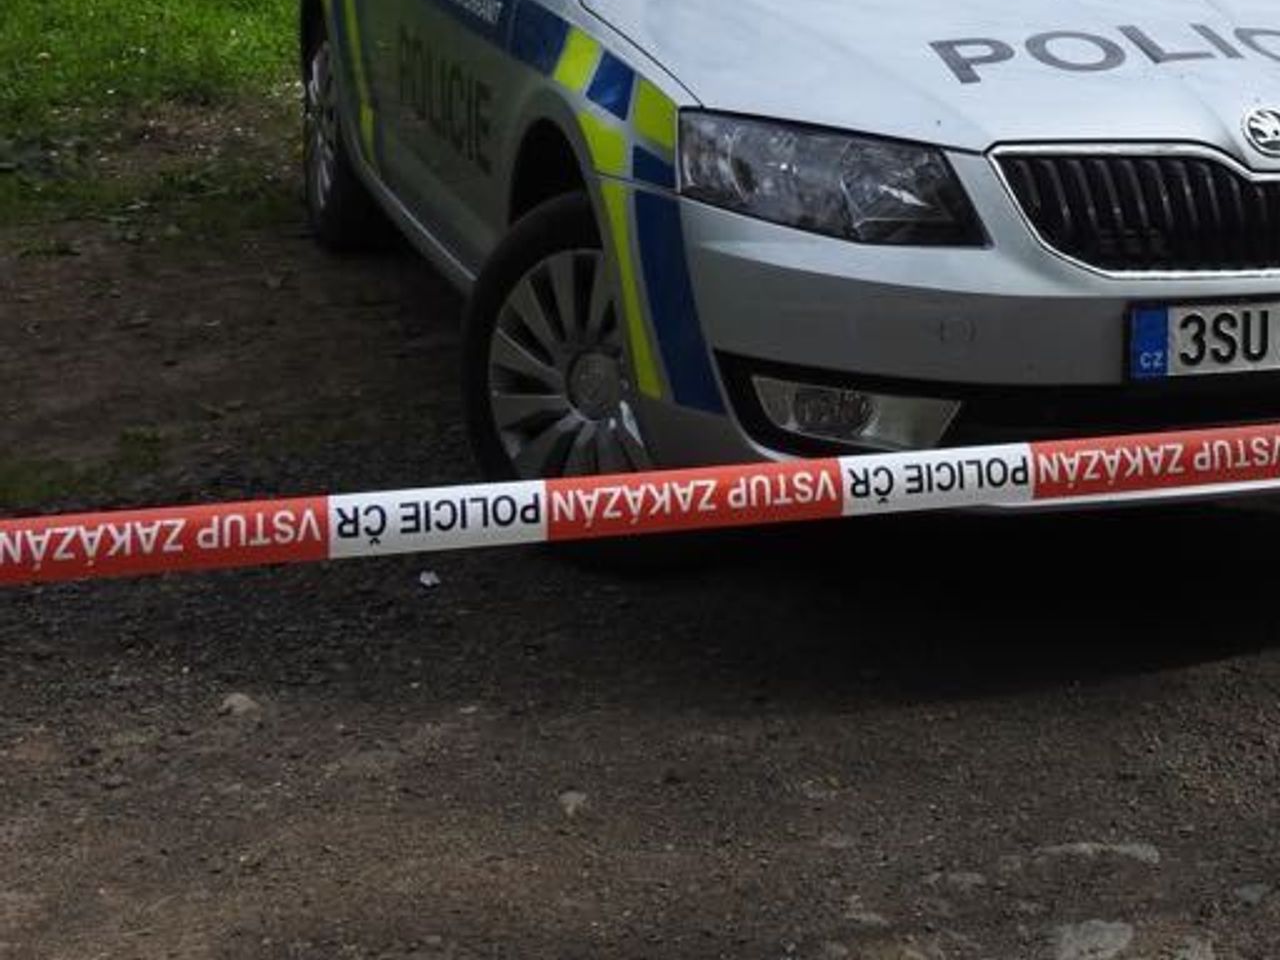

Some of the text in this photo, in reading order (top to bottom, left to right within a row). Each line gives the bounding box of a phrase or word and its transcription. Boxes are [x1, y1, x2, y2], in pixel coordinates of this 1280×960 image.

[399, 24, 492, 175] POLICIE
[1139, 351, 1164, 370] CZ
[1178, 309, 1269, 367] 3SU
[850, 455, 1029, 504] POLICIE ČR
[1039, 443, 1184, 490] ZAKÁZÁN
[336, 492, 540, 546] POLICIE ČR
[553, 470, 837, 529] VSTUP ZAKÁZÁN
[0, 509, 321, 571] VSTUP ZAKÁZÁN
